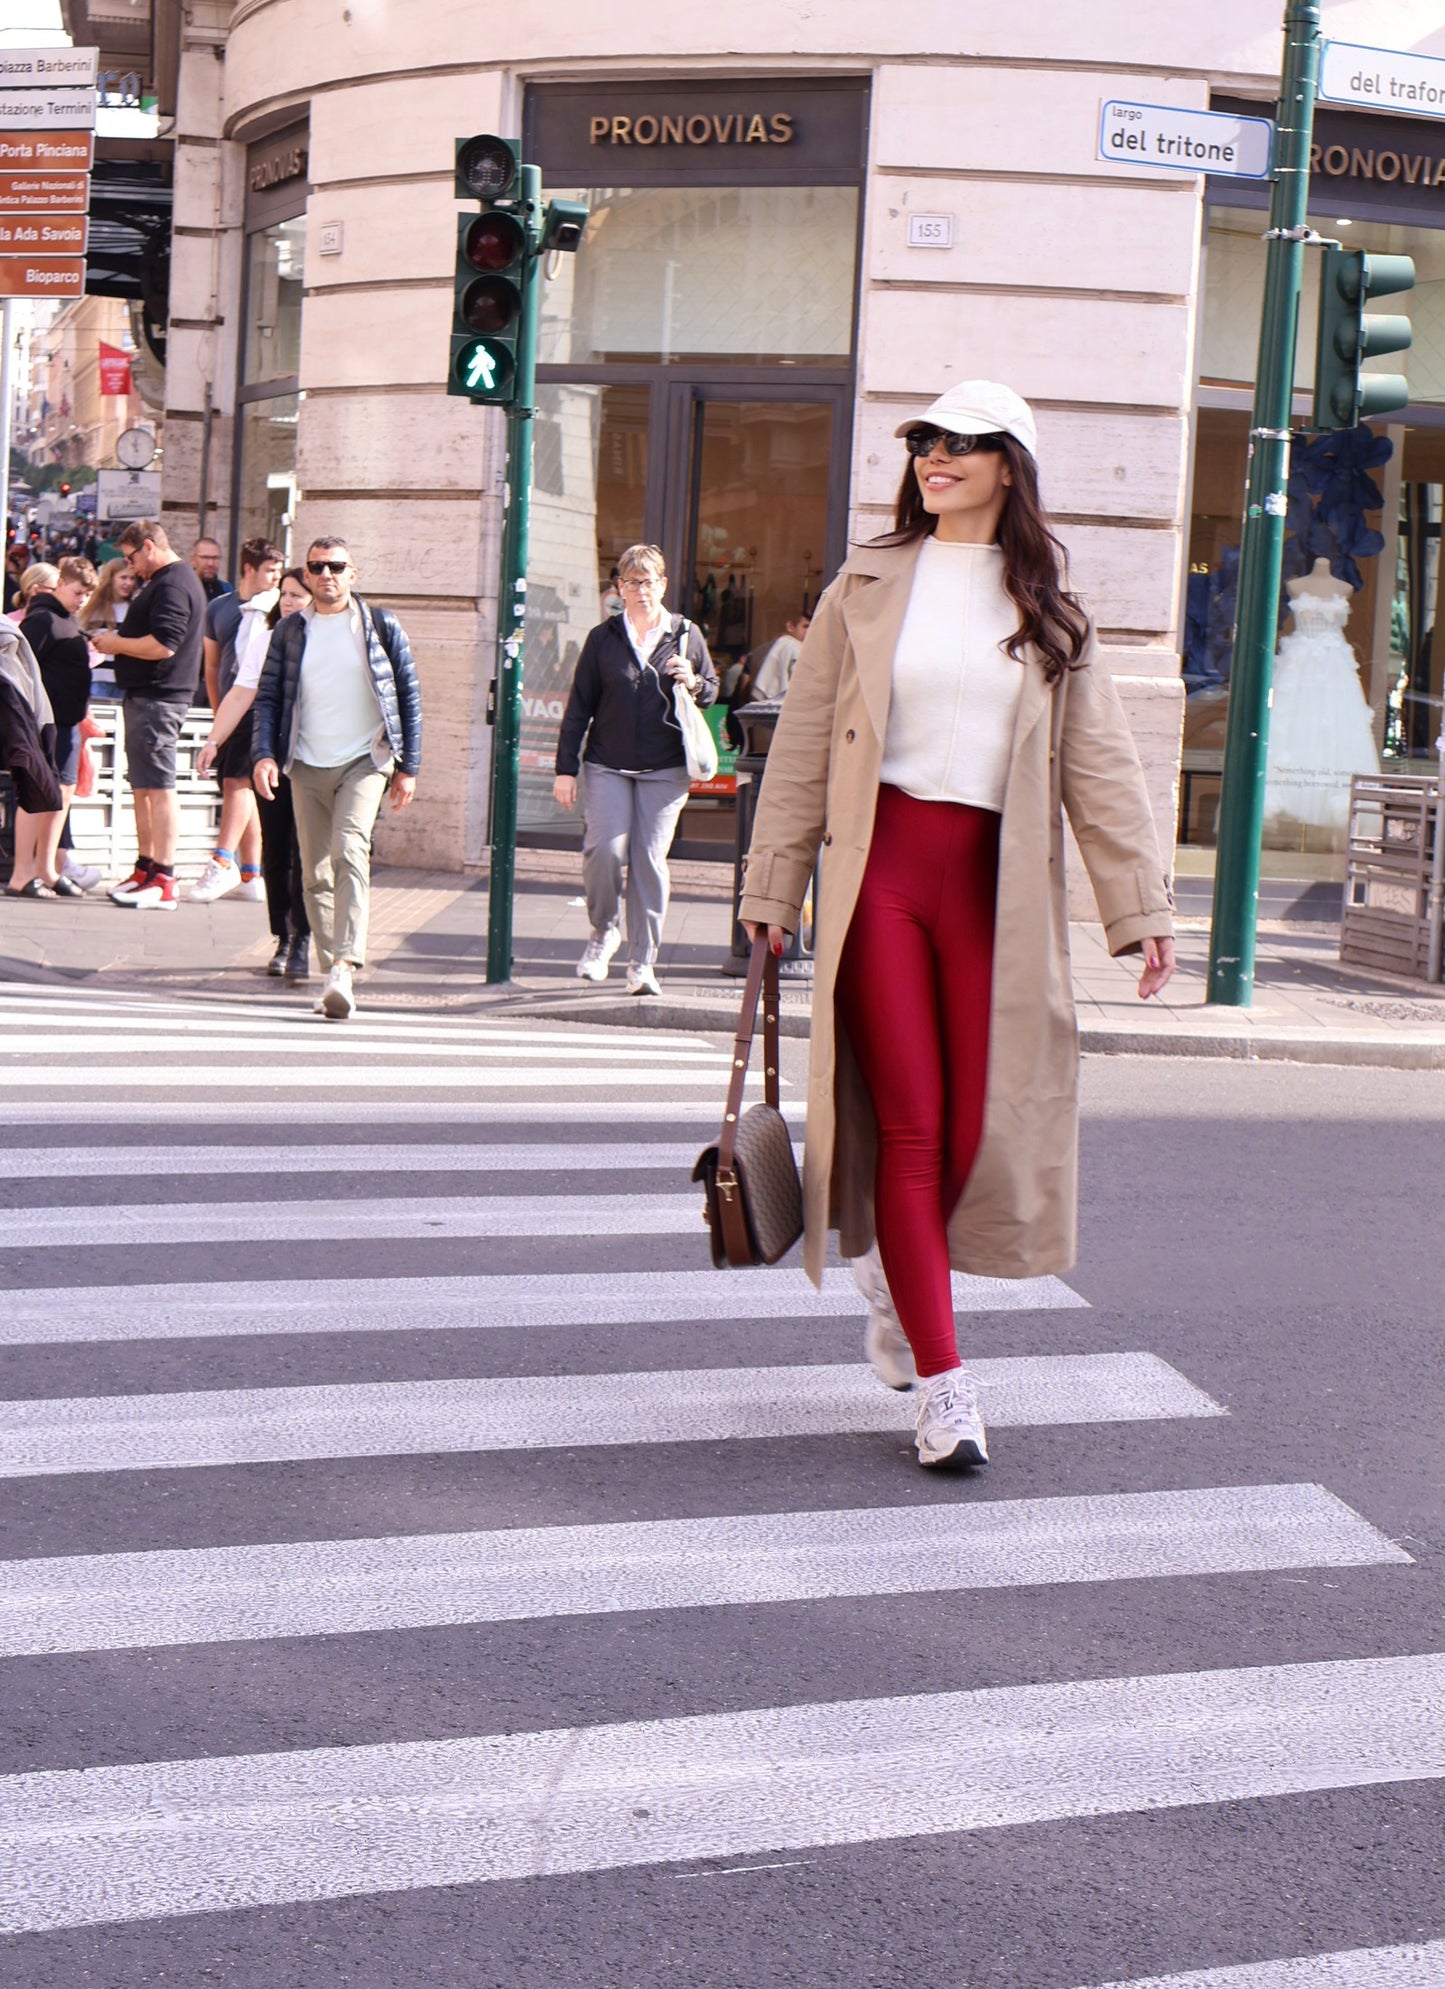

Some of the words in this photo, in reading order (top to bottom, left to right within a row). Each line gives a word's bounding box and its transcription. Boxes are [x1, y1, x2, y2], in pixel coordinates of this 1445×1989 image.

[37, 59, 92, 72] Barberini
[1350, 71, 1381, 94] del
[48, 101, 92, 115] Termini
[1112, 105, 1143, 121] largo
[590, 113, 794, 145] PRONOVIAS
[0, 143, 32, 158] Porta
[36, 143, 88, 158] Pinciana
[1112, 128, 1146, 151] del
[1157, 133, 1235, 162] tritone
[1310, 143, 1445, 186] RONOVIA
[14, 226, 38, 241] Ada
[41, 226, 82, 241] Savoia
[918, 223, 942, 238] 155
[26, 269, 79, 285] Bioparco
